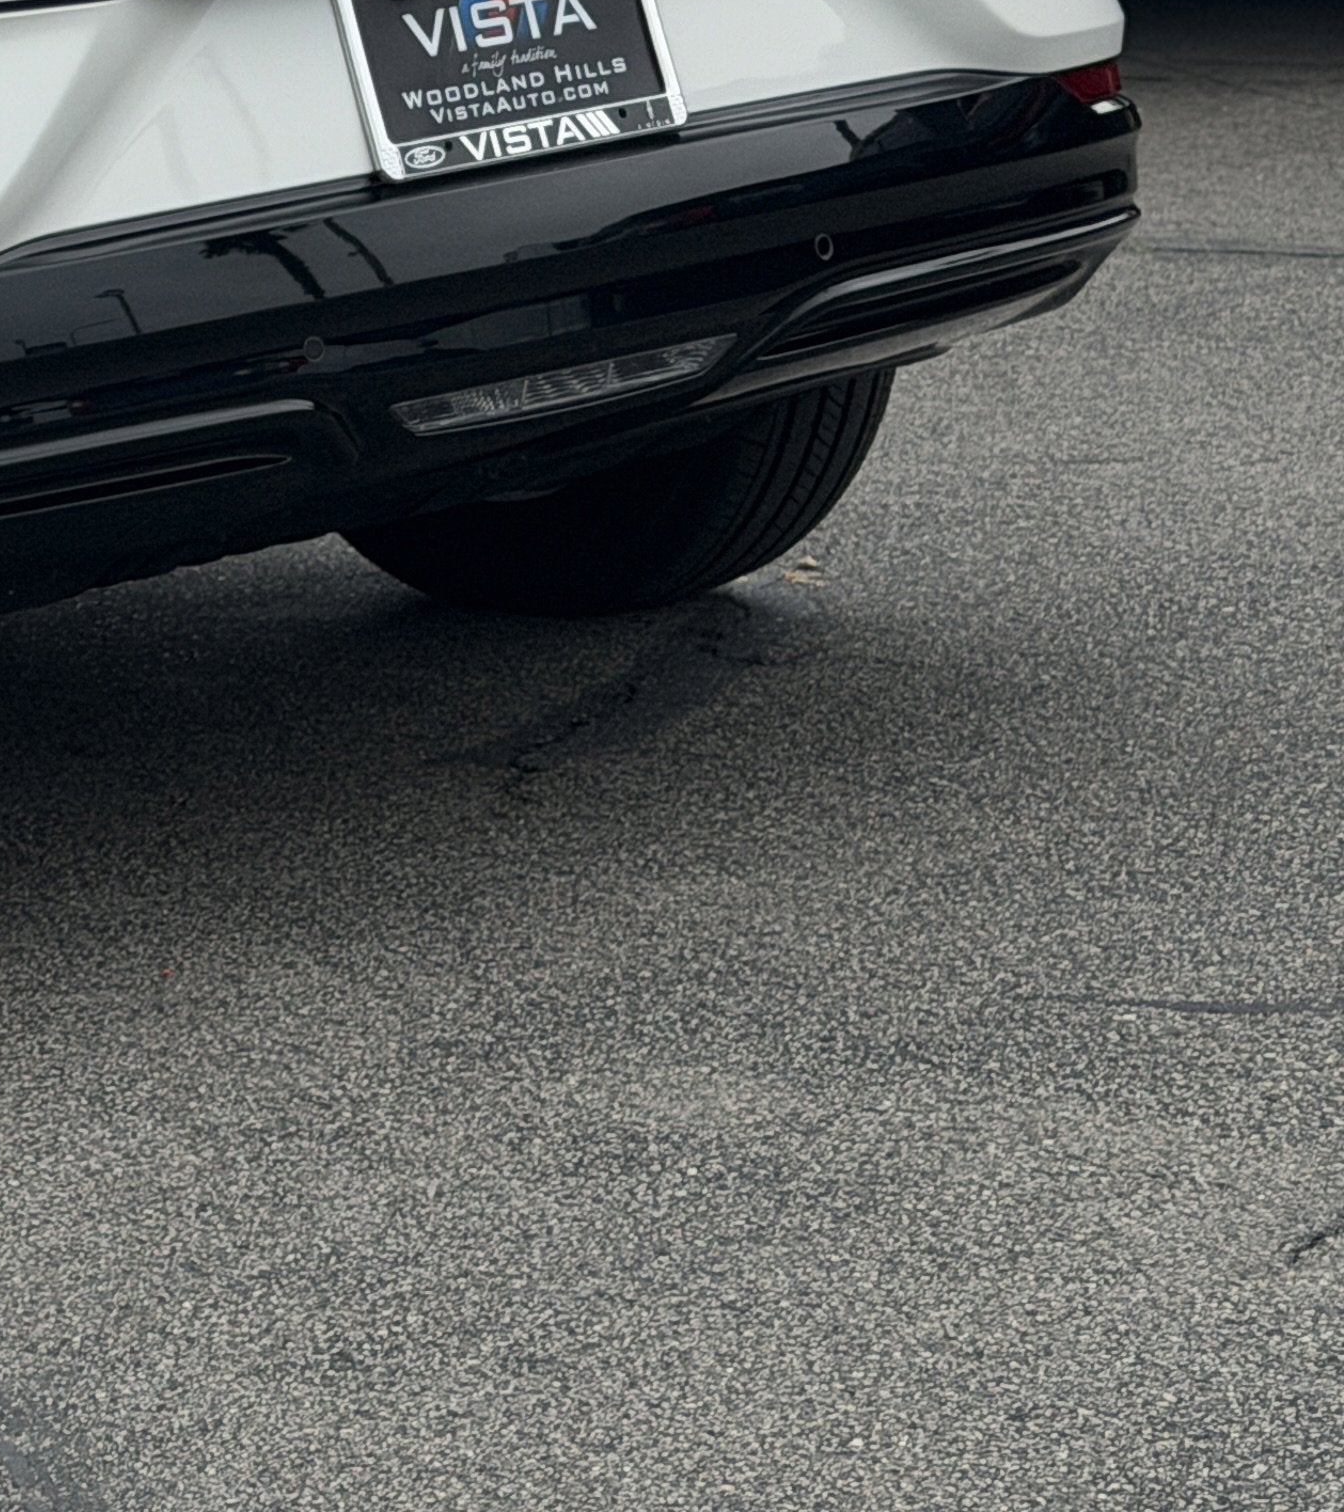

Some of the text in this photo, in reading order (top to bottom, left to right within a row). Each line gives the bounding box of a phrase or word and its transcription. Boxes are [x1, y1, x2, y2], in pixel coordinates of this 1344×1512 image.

[402, 57, 627, 110] WOODLAND HILLS
[470, 52, 506, 78] family
[511, 46, 557, 65] tradition
[459, 117, 579, 161] VISTA
